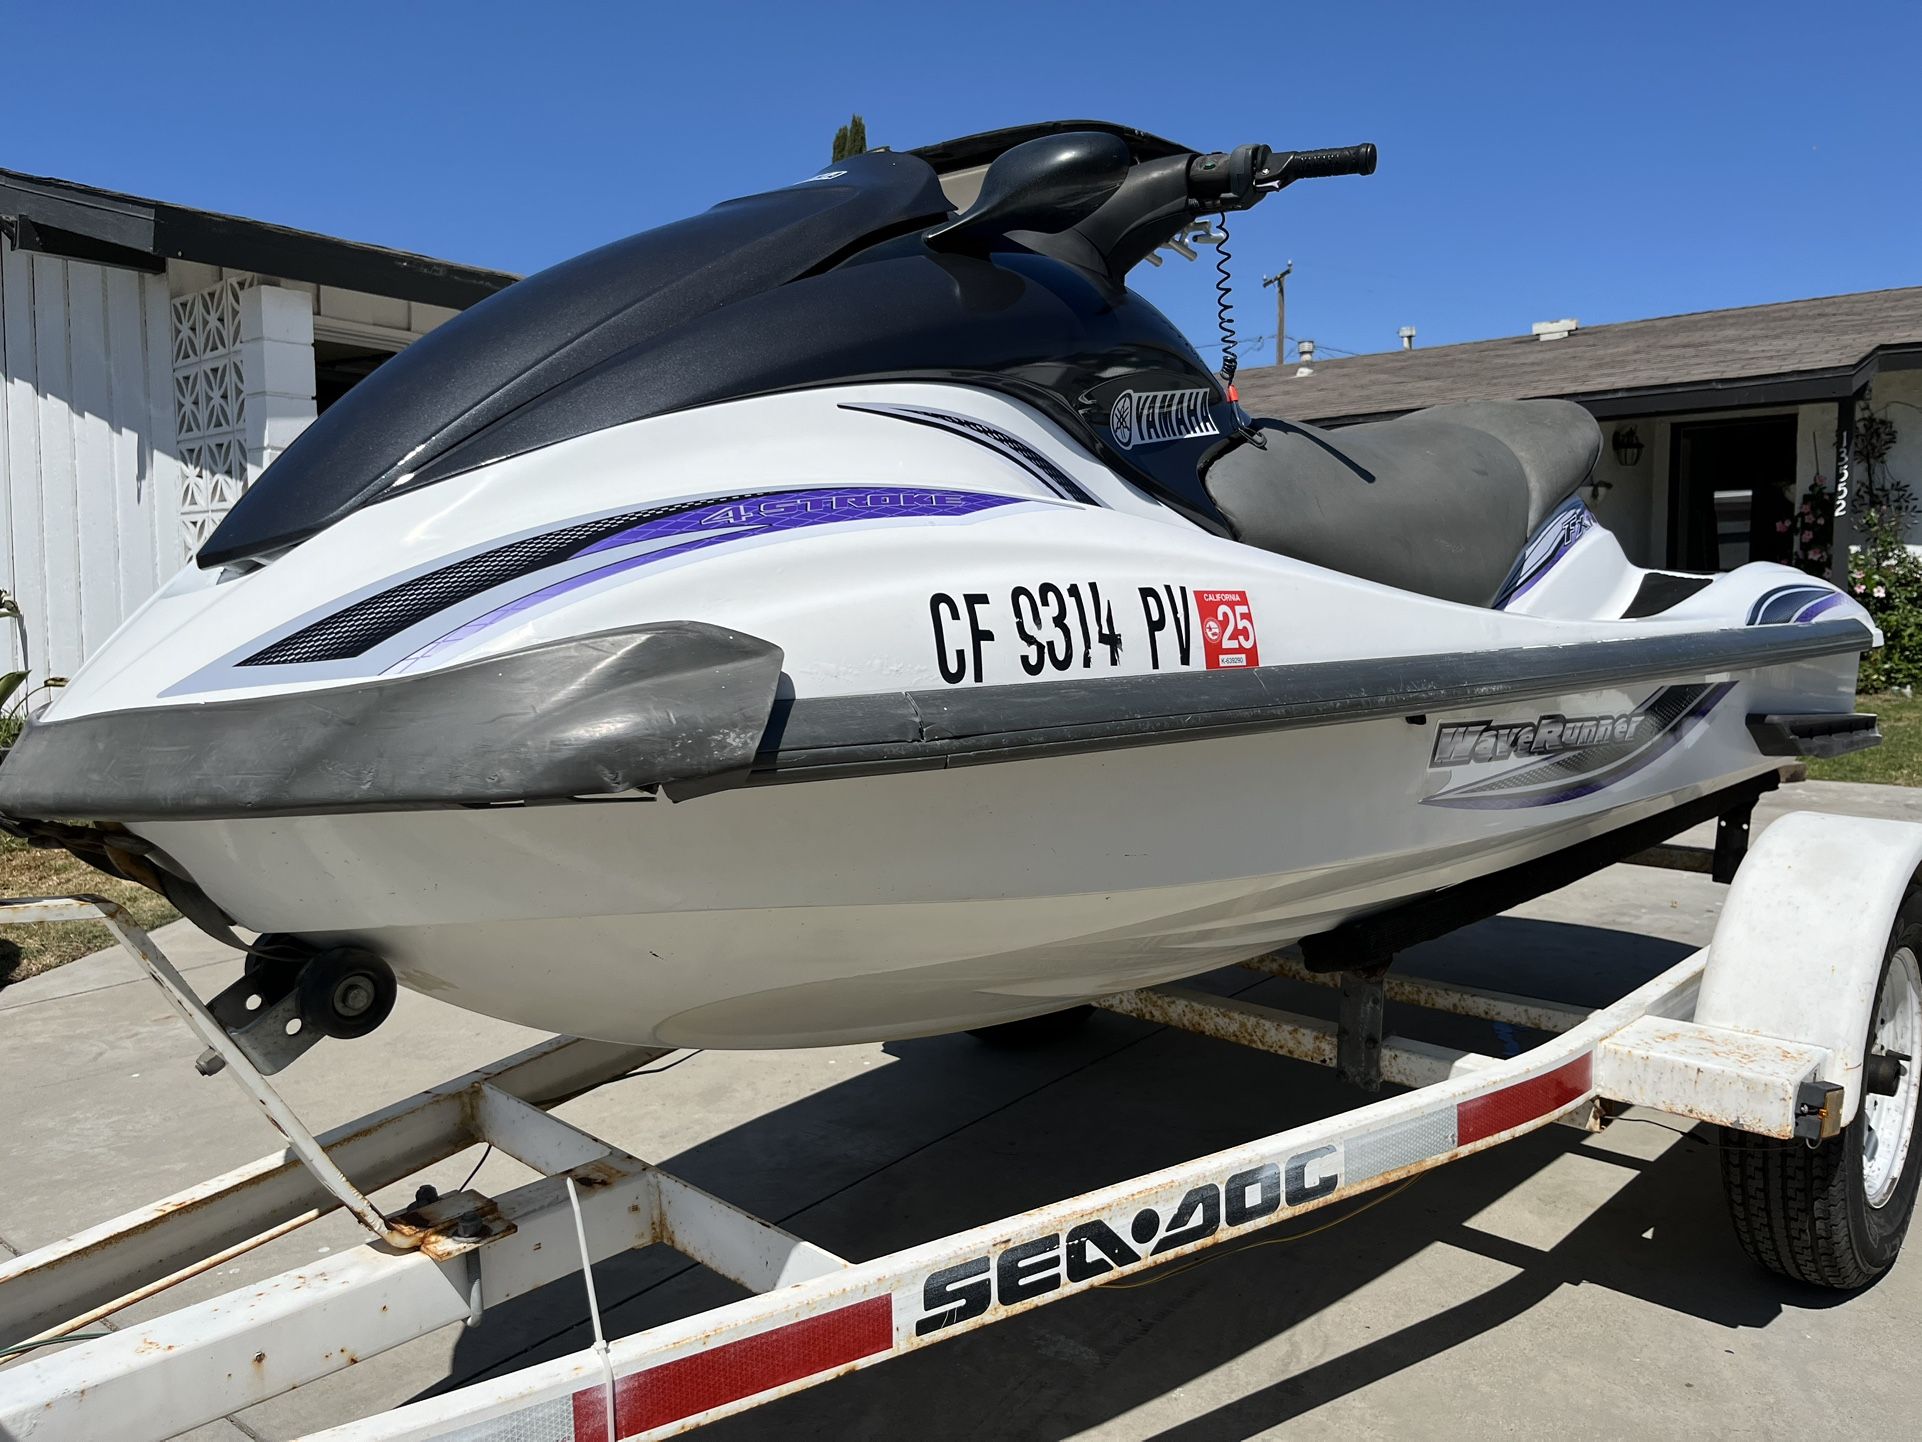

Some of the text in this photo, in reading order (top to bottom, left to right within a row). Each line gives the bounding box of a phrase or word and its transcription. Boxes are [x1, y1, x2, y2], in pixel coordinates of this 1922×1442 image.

[1135, 390, 1217, 442] YAMAHA
[1834, 431, 1849, 517] 13552
[699, 493, 966, 527] 4 STROKE
[1203, 594, 1241, 602] CALIFORNIA
[930, 582, 1191, 684] CF 9314 PV
[1217, 604, 1255, 649] 25
[1432, 713, 1645, 765] WaveRunner
